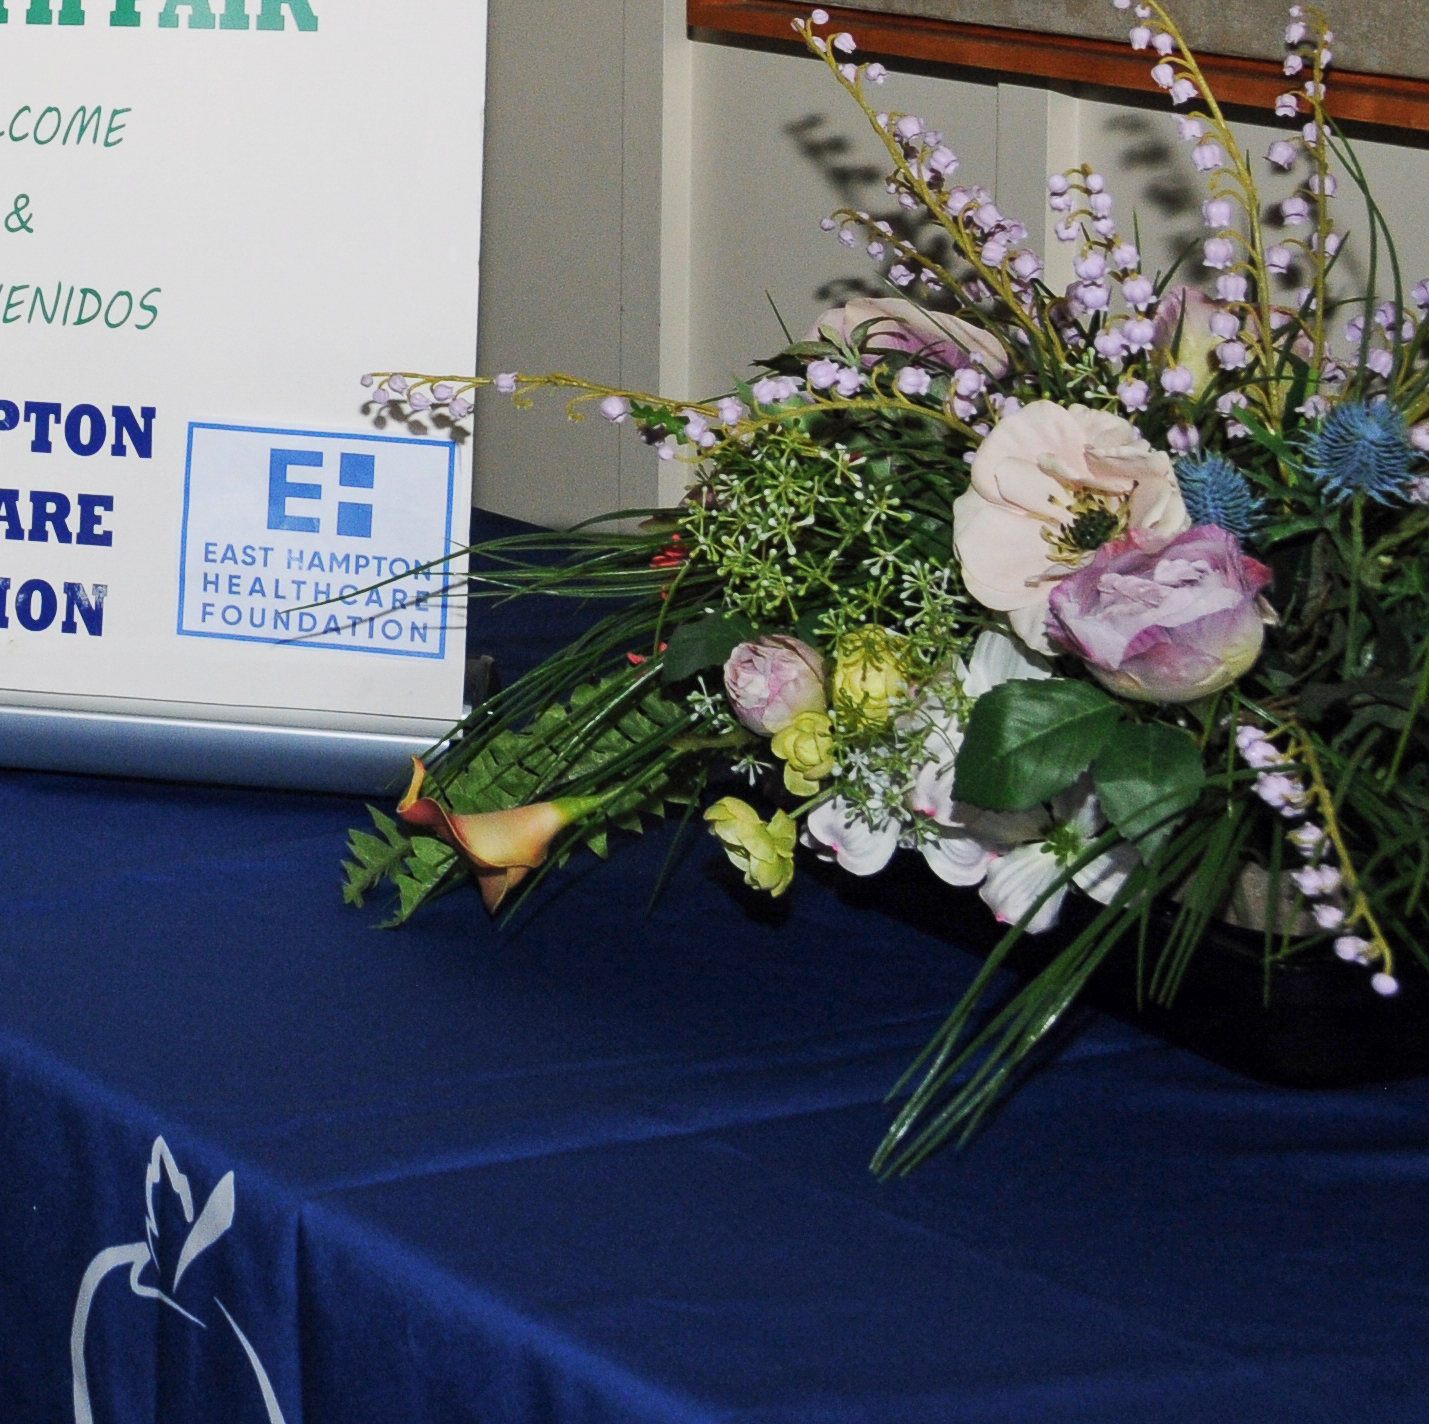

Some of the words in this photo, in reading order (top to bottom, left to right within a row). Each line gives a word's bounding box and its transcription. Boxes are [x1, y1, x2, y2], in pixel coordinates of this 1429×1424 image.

[3, 193, 35, 235] &
[203, 541, 274, 568] EAST
[286, 548, 432, 582] HAMPTON
[201, 572, 431, 613] HEALTHCARE
[200, 602, 429, 644] FOUNDATION
